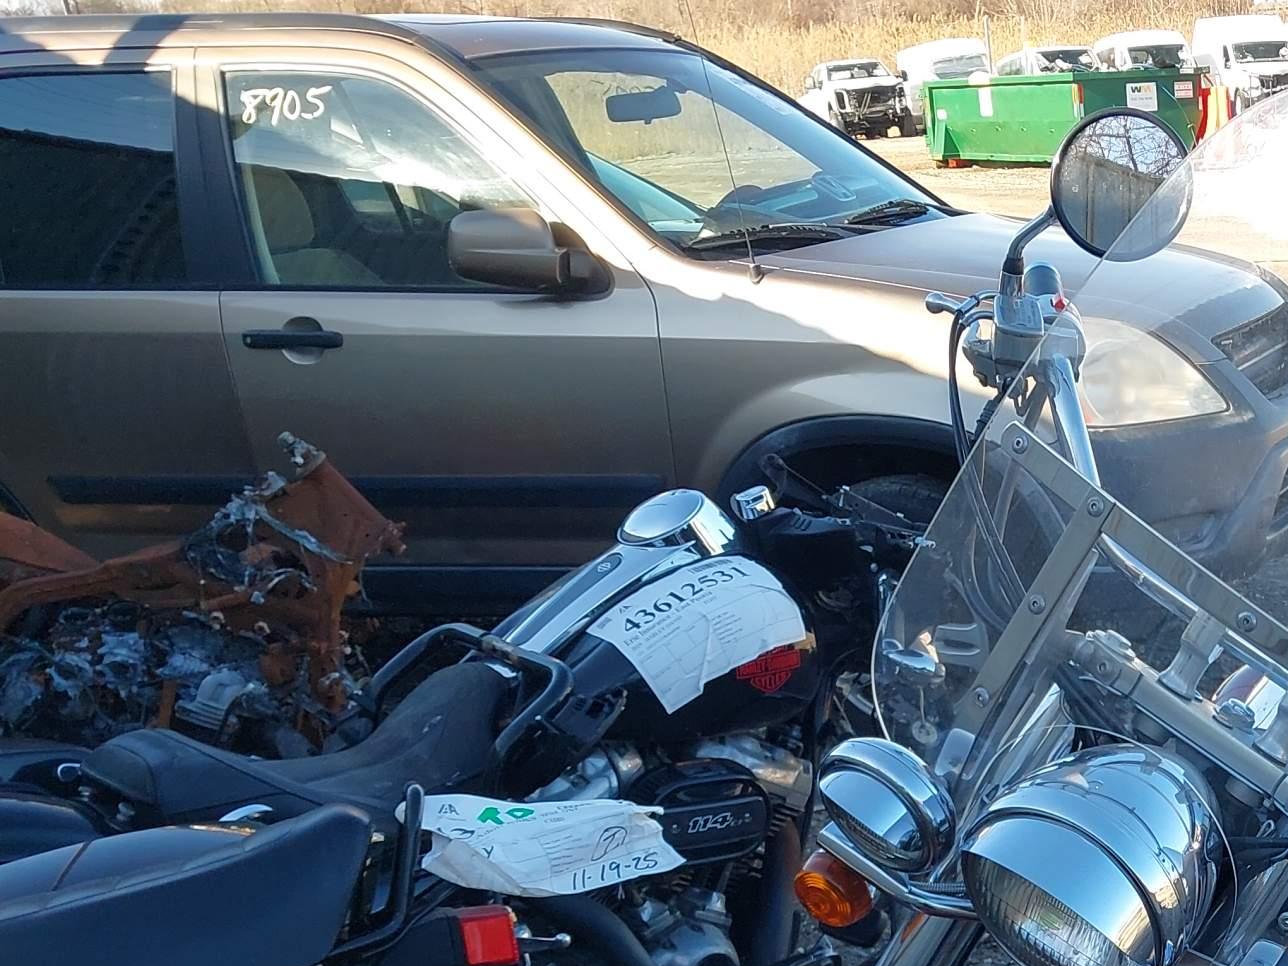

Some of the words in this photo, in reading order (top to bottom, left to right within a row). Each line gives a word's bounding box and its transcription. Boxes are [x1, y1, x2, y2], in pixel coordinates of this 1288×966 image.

[240, 86, 333, 127] 8905
[625, 567, 750, 632] 43612531
[688, 812, 732, 834] 114
[573, 851, 659, 891] 11-19-25
